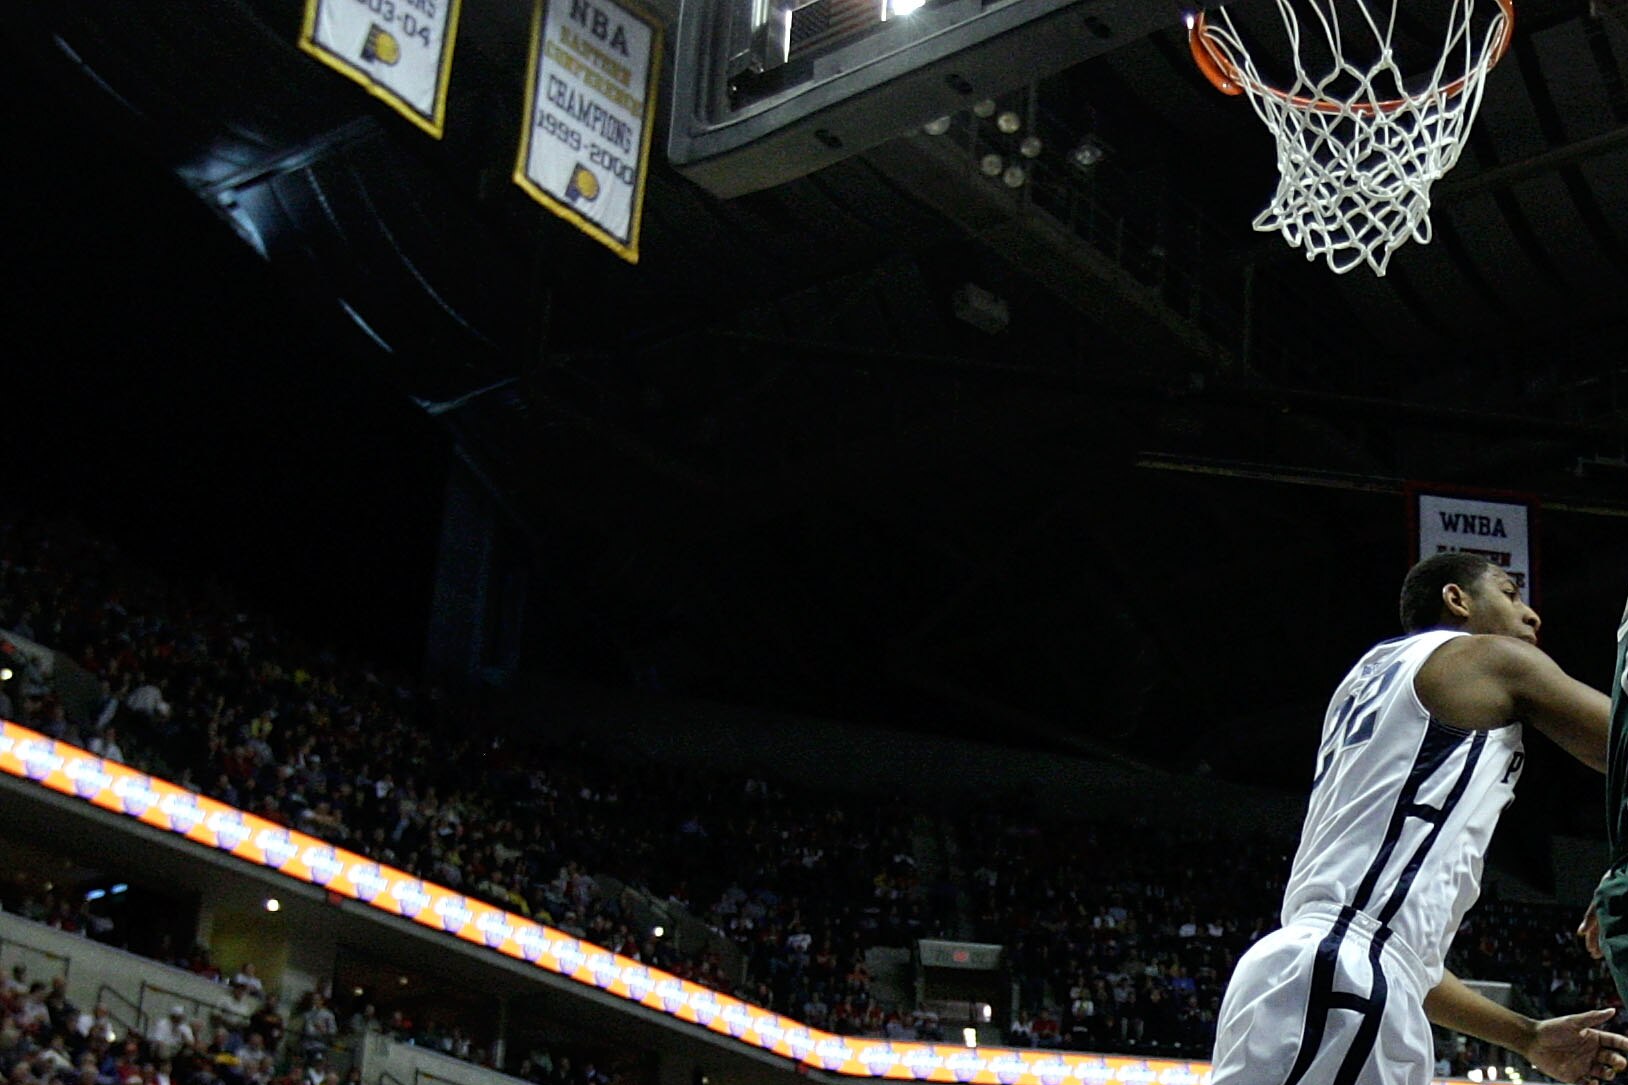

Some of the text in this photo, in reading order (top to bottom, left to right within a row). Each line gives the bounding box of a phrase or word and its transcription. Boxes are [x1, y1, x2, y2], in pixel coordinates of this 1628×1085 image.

[569, 0, 629, 57] NBA
[536, 108, 634, 186] 1999-2000
[547, 74, 634, 155] CHAMPIONS
[1440, 512, 1507, 538] WNBA
